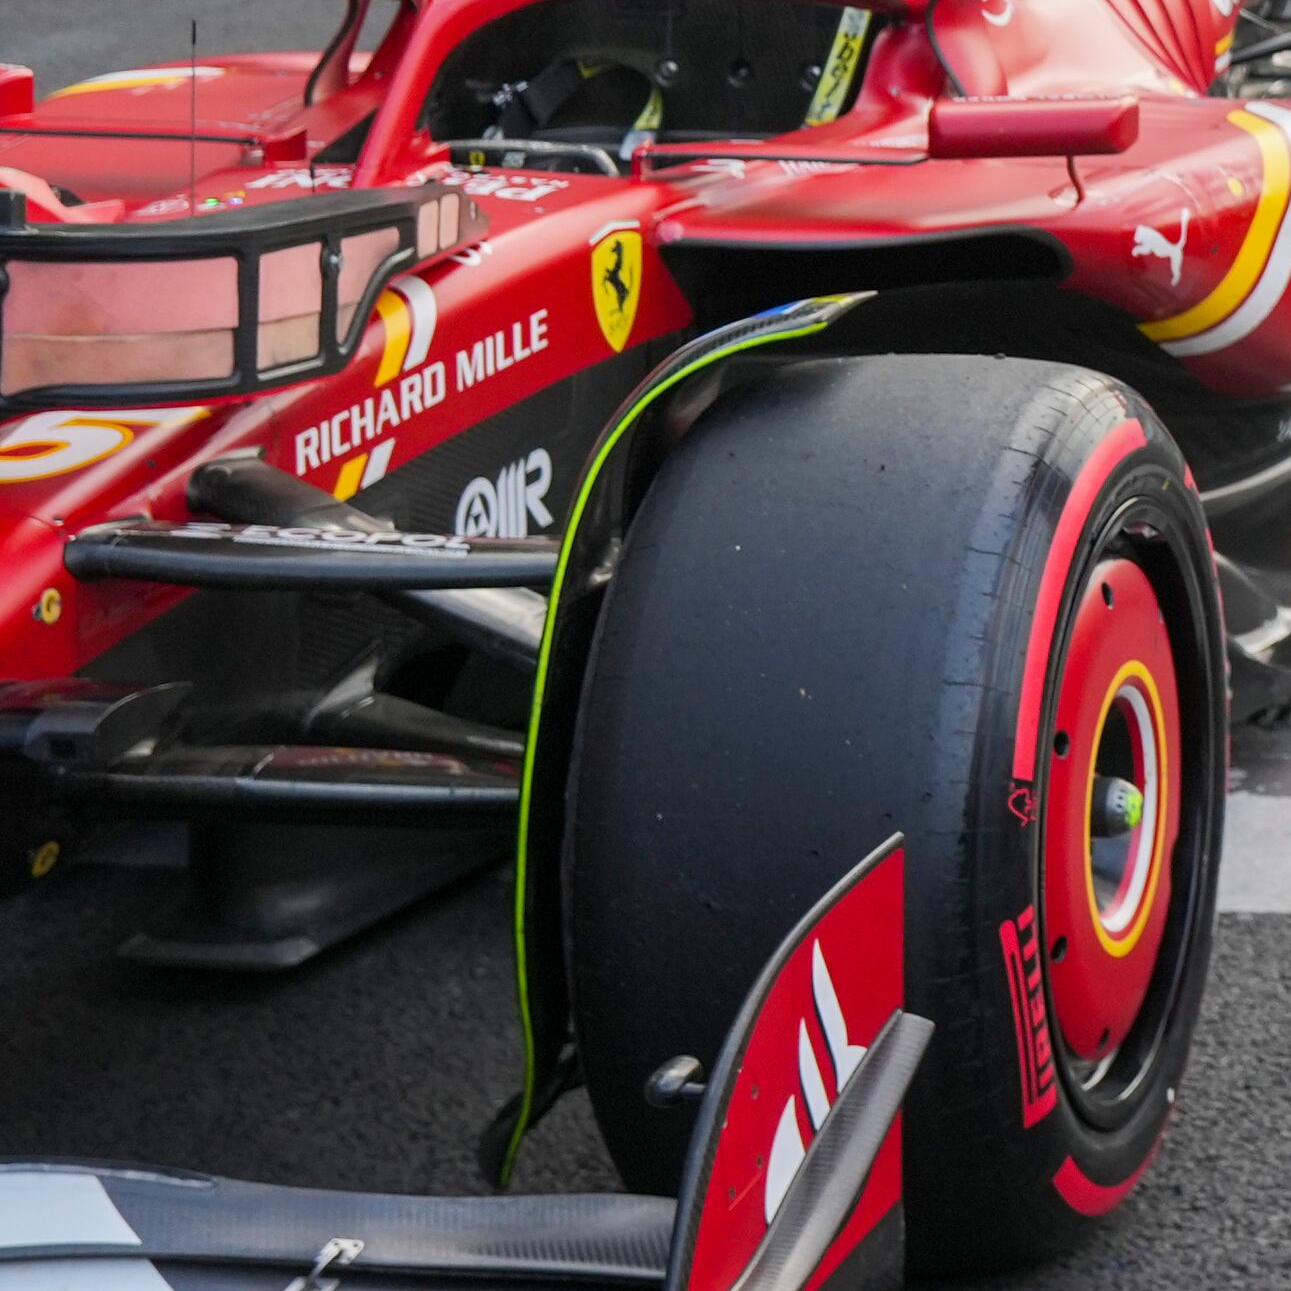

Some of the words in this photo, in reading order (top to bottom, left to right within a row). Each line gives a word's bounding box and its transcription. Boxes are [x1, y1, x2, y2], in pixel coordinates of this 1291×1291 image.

[295, 360, 446, 476] RICHARD
[455, 308, 550, 393] MILLE
[237, 524, 471, 551] ECOPOL
[998, 904, 1058, 1130] PIRELLI
